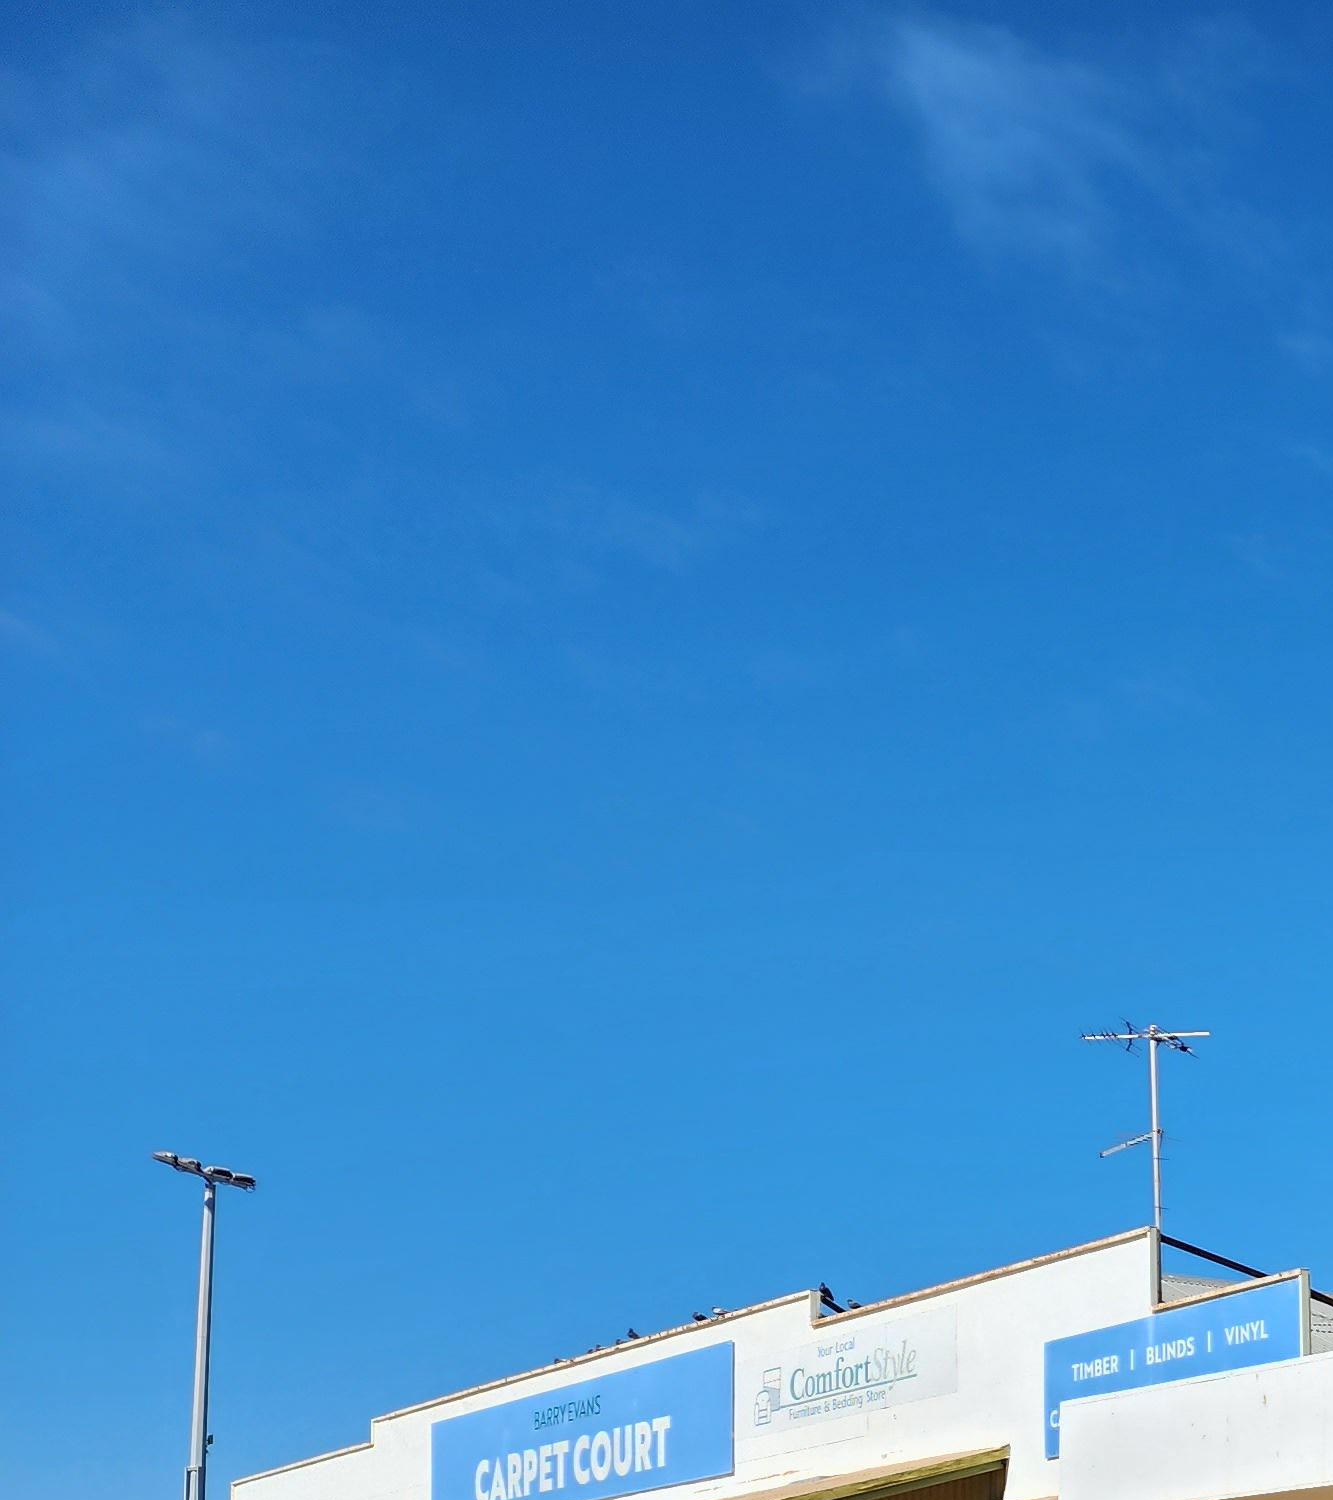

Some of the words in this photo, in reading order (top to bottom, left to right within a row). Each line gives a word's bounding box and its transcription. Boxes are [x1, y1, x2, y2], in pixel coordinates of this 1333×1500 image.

[790, 1338, 917, 1401] ComfortStyle
[836, 1338, 855, 1354] Local
[1072, 1355, 1119, 1381] TIMBER
[1146, 1337, 1195, 1365] BLINDS
[1225, 1320, 1268, 1345] VINYL
[534, 1404, 566, 1430] BARRY
[568, 1395, 600, 1422] EVANS
[789, 1404, 822, 1420] Furniture
[832, 1396, 863, 1412] Bedding
[866, 1390, 886, 1403] Store
[573, 1415, 671, 1485] COURT
